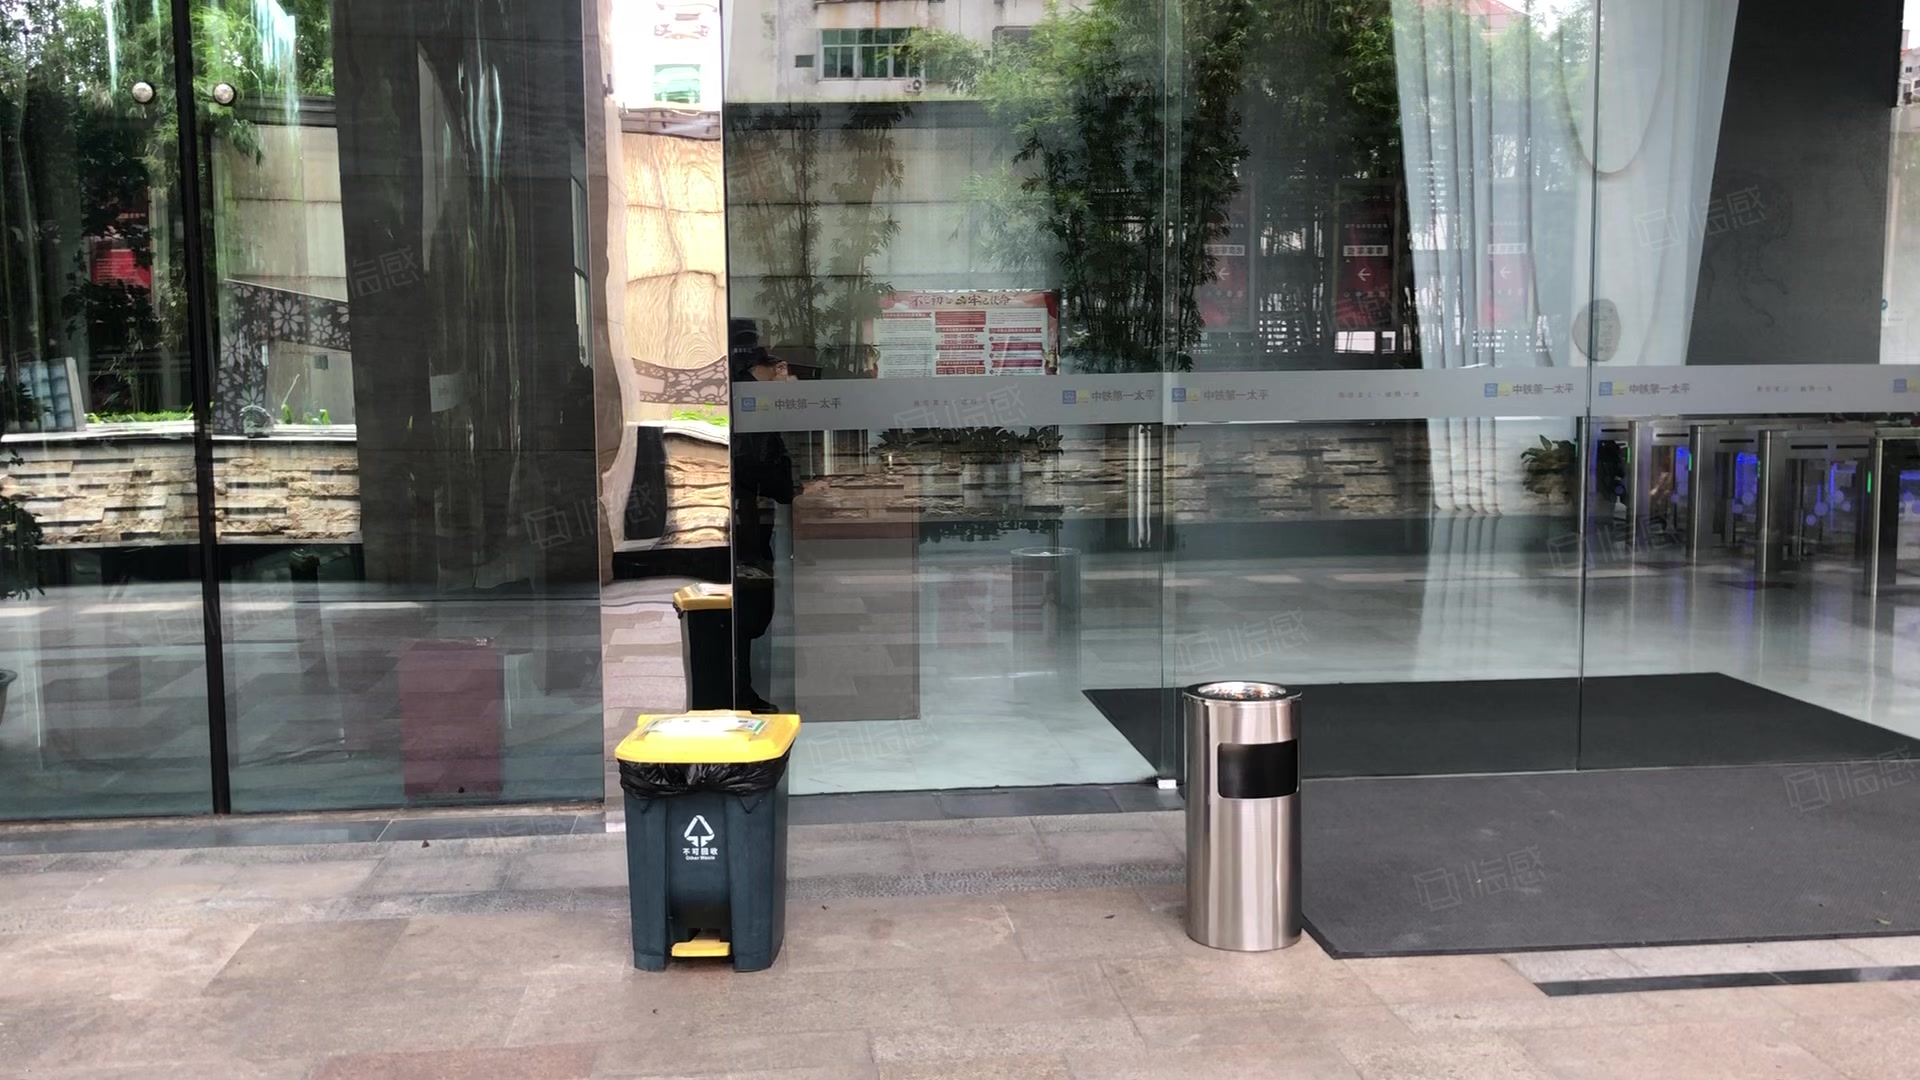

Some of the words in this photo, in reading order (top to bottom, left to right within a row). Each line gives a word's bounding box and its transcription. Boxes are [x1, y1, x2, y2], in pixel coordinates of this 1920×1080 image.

[1512, 383, 1575, 395] 中铁第一太平
[1629, 383, 1690, 394] 中铁第一太平
[1091, 389, 1156, 401] 中铁第一太平
[1203, 389, 1269, 401] 中铁第一太平
[774, 397, 842, 410] 中铁第一太平
[682, 847, 718, 856] 不可回收
